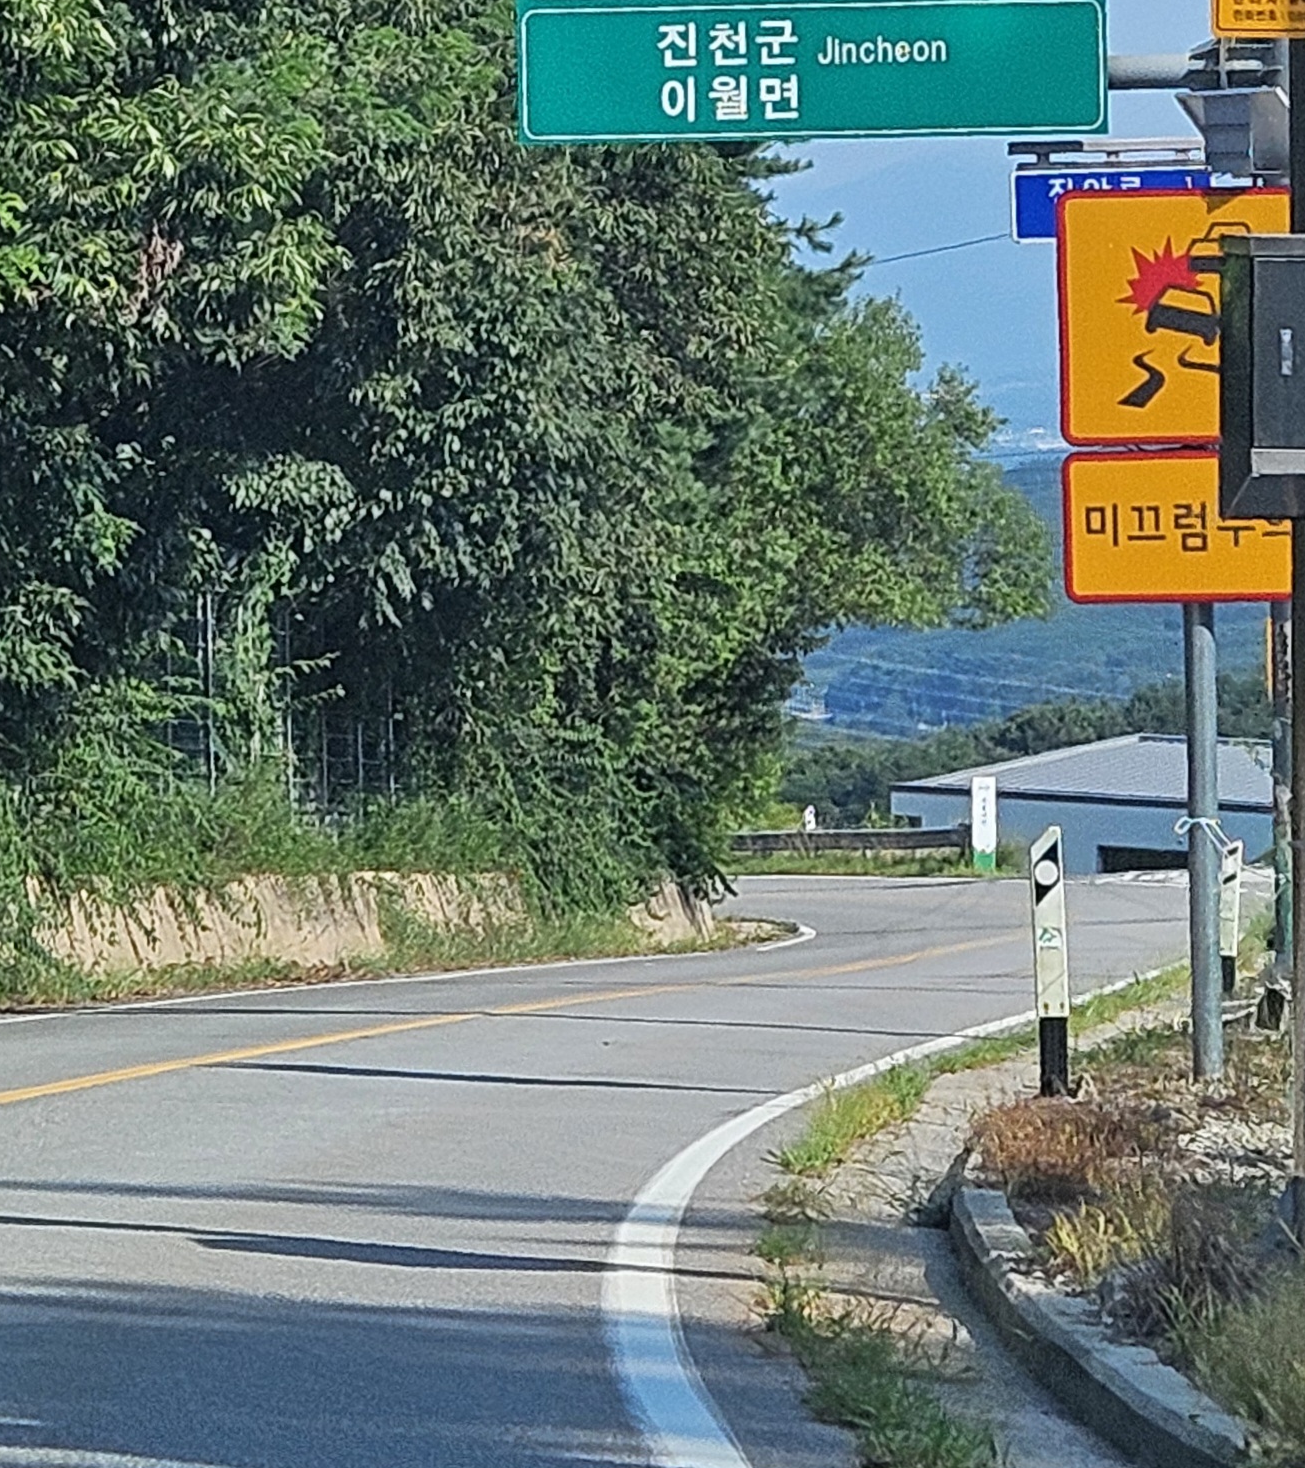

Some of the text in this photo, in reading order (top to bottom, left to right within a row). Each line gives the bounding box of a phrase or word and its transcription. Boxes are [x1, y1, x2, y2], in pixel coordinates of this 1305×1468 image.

[657, 19, 947, 67] 진천군 Jincheon
[660, 74, 799, 122] 이월면
